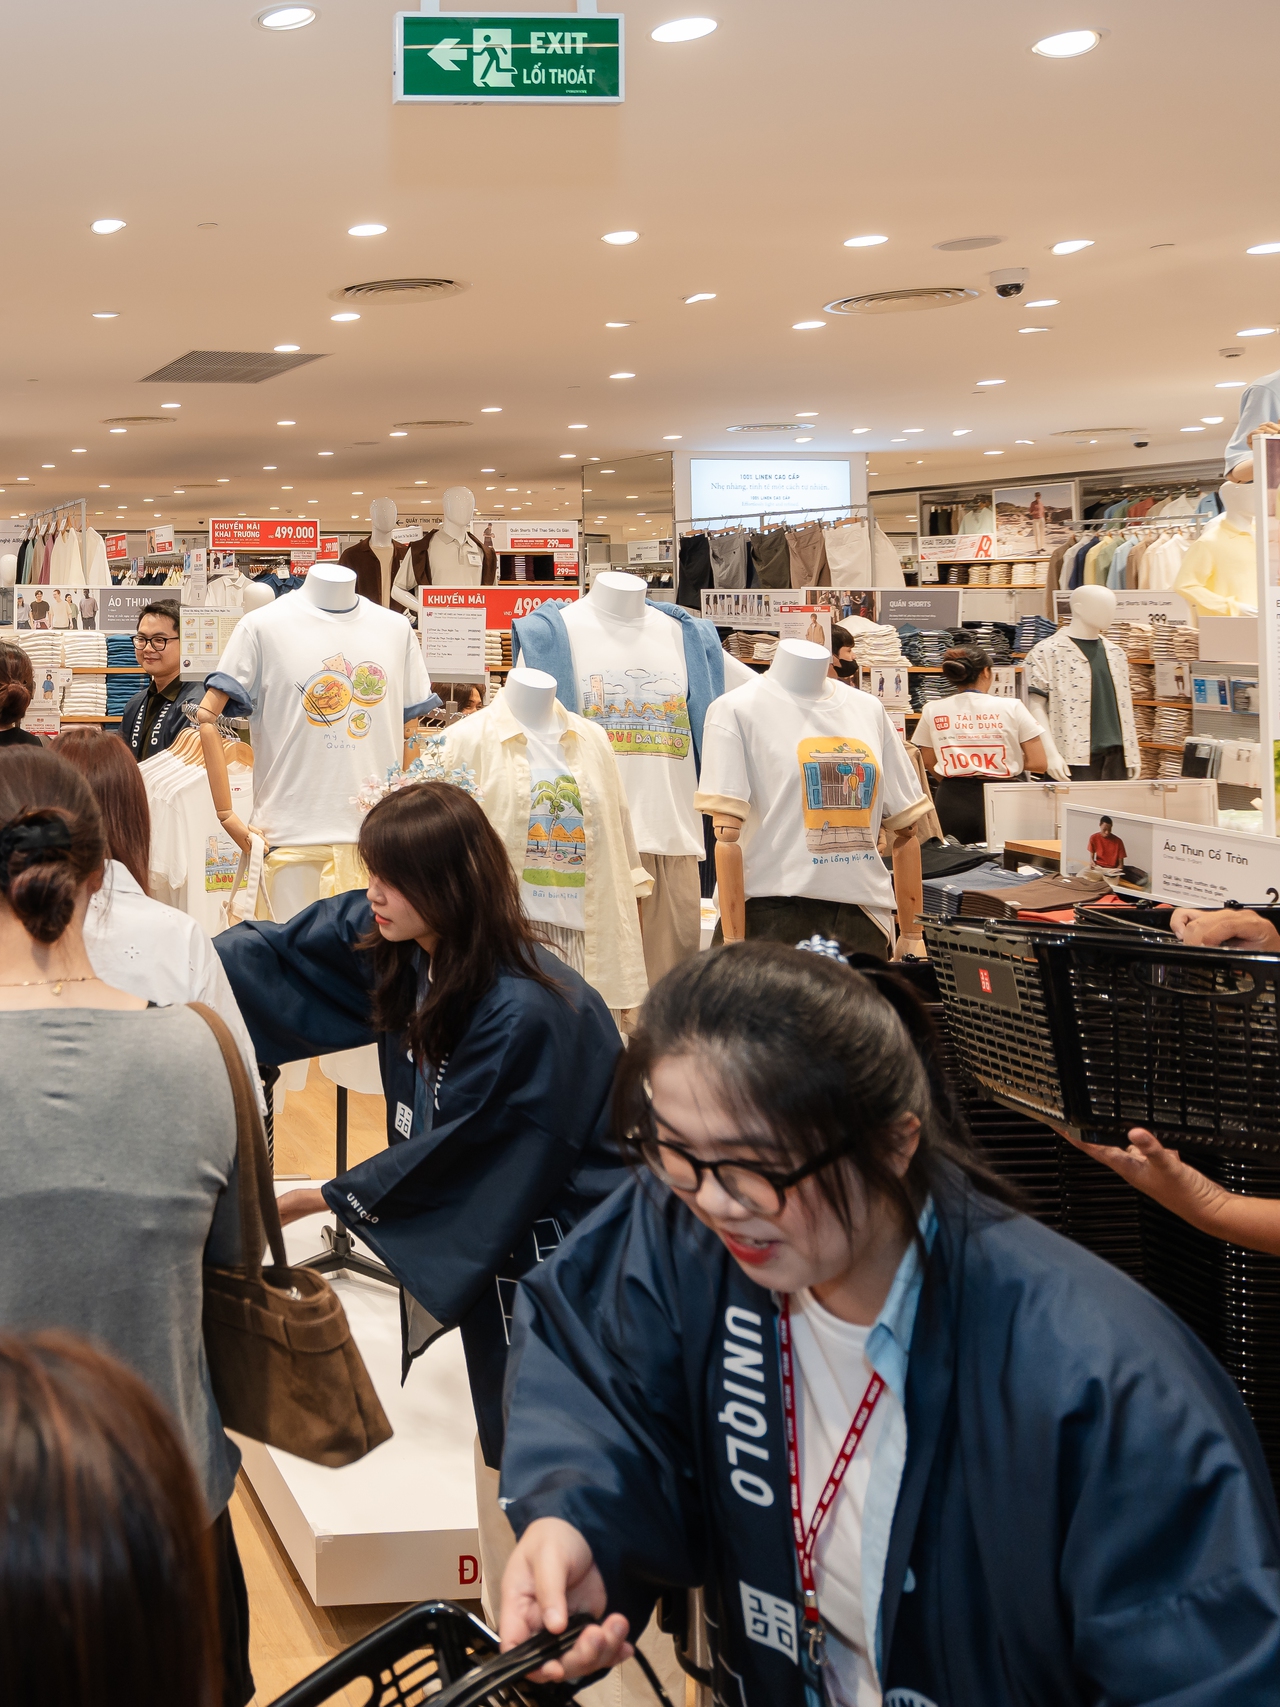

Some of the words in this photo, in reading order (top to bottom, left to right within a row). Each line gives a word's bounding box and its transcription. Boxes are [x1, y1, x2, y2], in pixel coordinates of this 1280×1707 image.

[530, 31, 588, 54] EXIT
[549, 65, 595, 85] THOÁT
[215, 521, 243, 530] KHUYẾN
[247, 521, 260, 530] MÃI
[275, 526, 314, 539] 499.000
[108, 595, 121, 607] ÁO
[125, 598, 151, 607] THUN
[428, 592, 464, 604] KHUYẾN
[468, 593, 485, 604] MÃI
[889, 599, 906, 608] QUẦN
[1148, 613, 1167, 625] 399
[957, 713, 972, 721] TẢI
[976, 713, 1000, 721] NGAY
[955, 721, 973, 730] ỨNG
[978, 722, 1004, 731] DỤNG
[326, 740, 356, 750] Quảng
[607, 731, 632, 743] OVE
[635, 732, 652, 744] DA
[654, 733, 684, 748] NANG
[949, 753, 999, 770] 100K
[1163, 839, 1176, 852] Áo
[1181, 844, 1204, 858] Thun
[1208, 849, 1221, 860] Cổ
[1226, 852, 1248, 865] Tròn
[812, 856, 828, 865] Đèn
[215, 874, 234, 883] LOV
[346, 1193, 379, 1224] UNIQLO
[718, 1305, 775, 1507] UNIQLO
[458, 1554, 481, 1585] Đ
